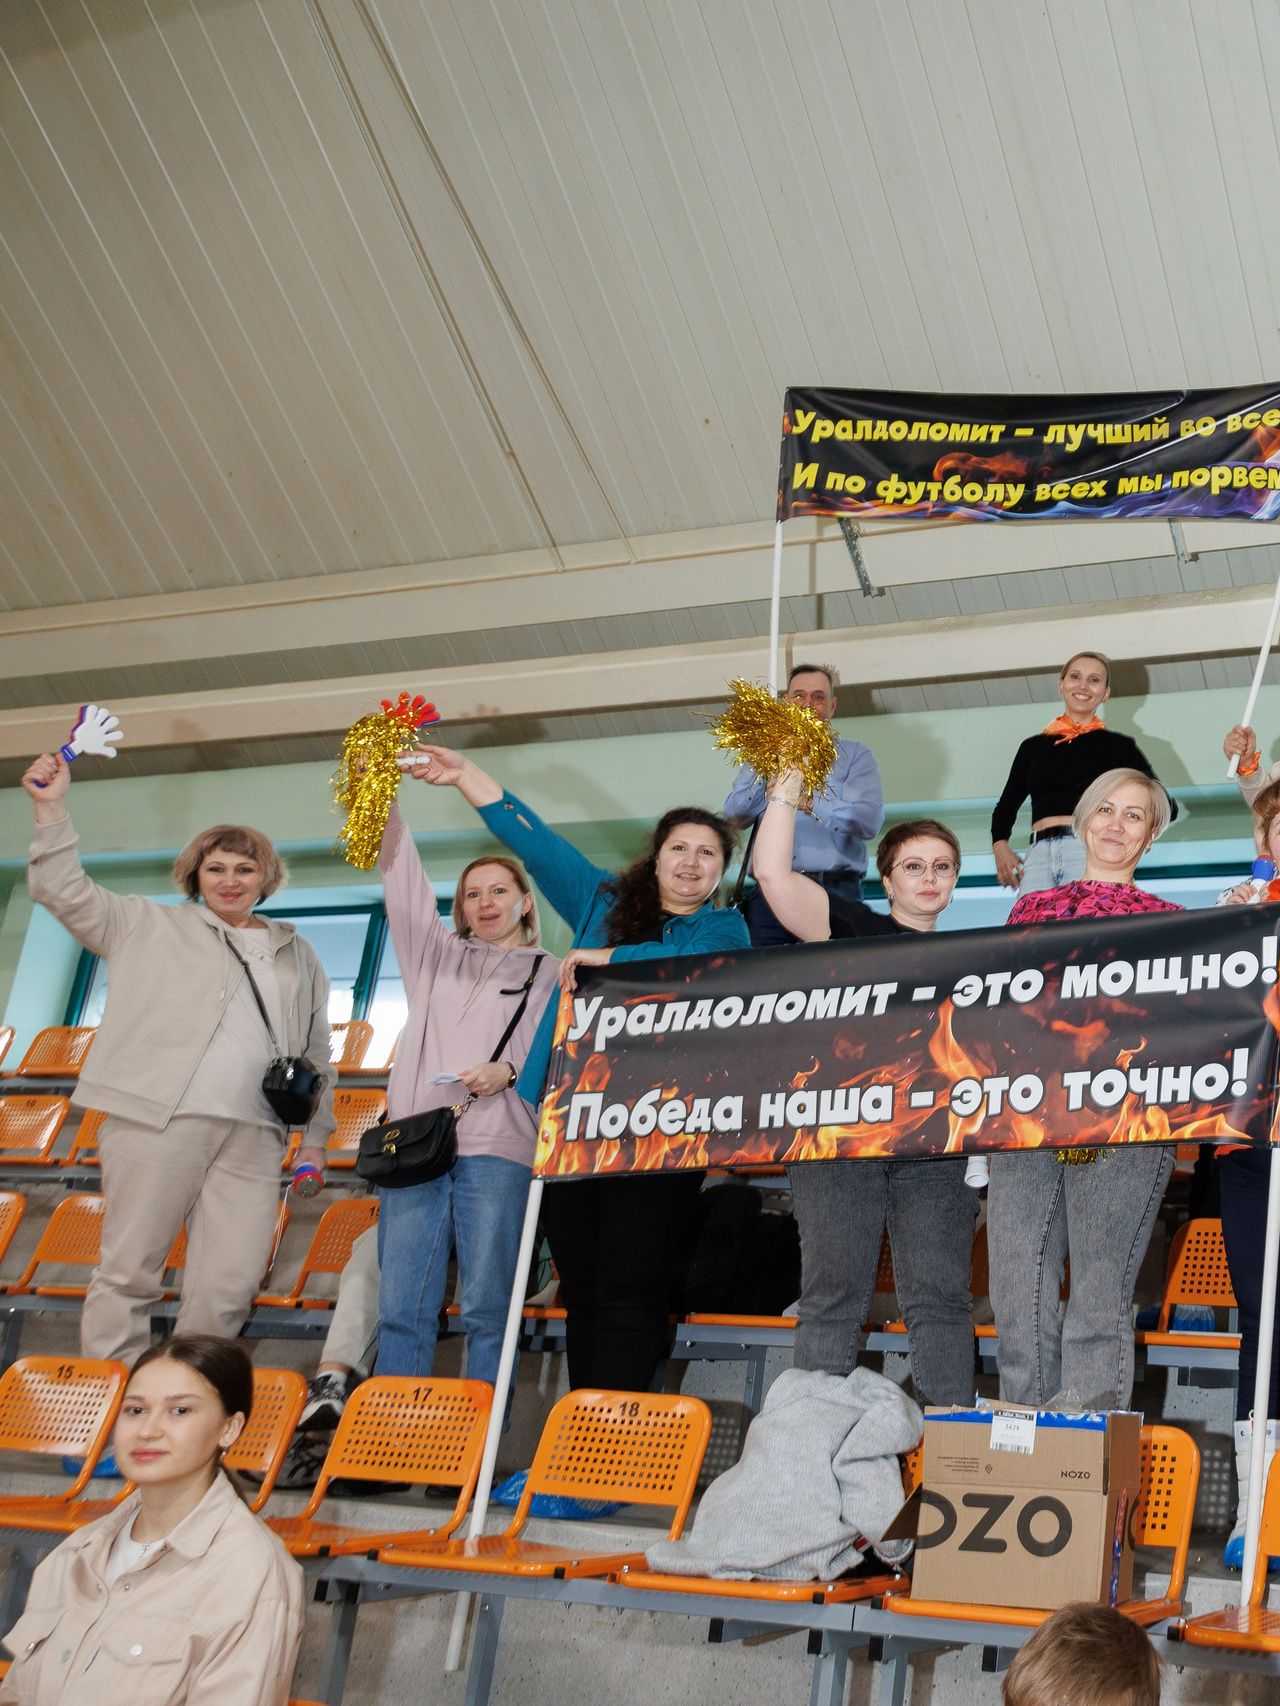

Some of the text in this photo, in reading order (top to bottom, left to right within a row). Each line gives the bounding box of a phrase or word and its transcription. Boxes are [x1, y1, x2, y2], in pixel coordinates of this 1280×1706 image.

[791, 409, 1006, 444] Уралдоломит
[1042, 416, 1170, 452] лучший
[1180, 416, 1217, 438] во
[791, 462, 820, 490] И
[825, 471, 867, 494] по
[876, 471, 1026, 510] футболу
[1034, 479, 1108, 502] всех
[1117, 473, 1163, 495] мы
[566, 981, 899, 1053] Уралдоломит
[951, 968, 1045, 1008] это
[1060, 935, 1279, 1000] мощно!
[565, 1088, 744, 1142] Победа
[758, 1084, 893, 1130] наша
[950, 1073, 1044, 1120] это
[1062, 1047, 1254, 1112] точно!
[57, 1364, 75, 1379] 15
[413, 1386, 433, 1402] 17
[619, 1401, 640, 1417] 18
